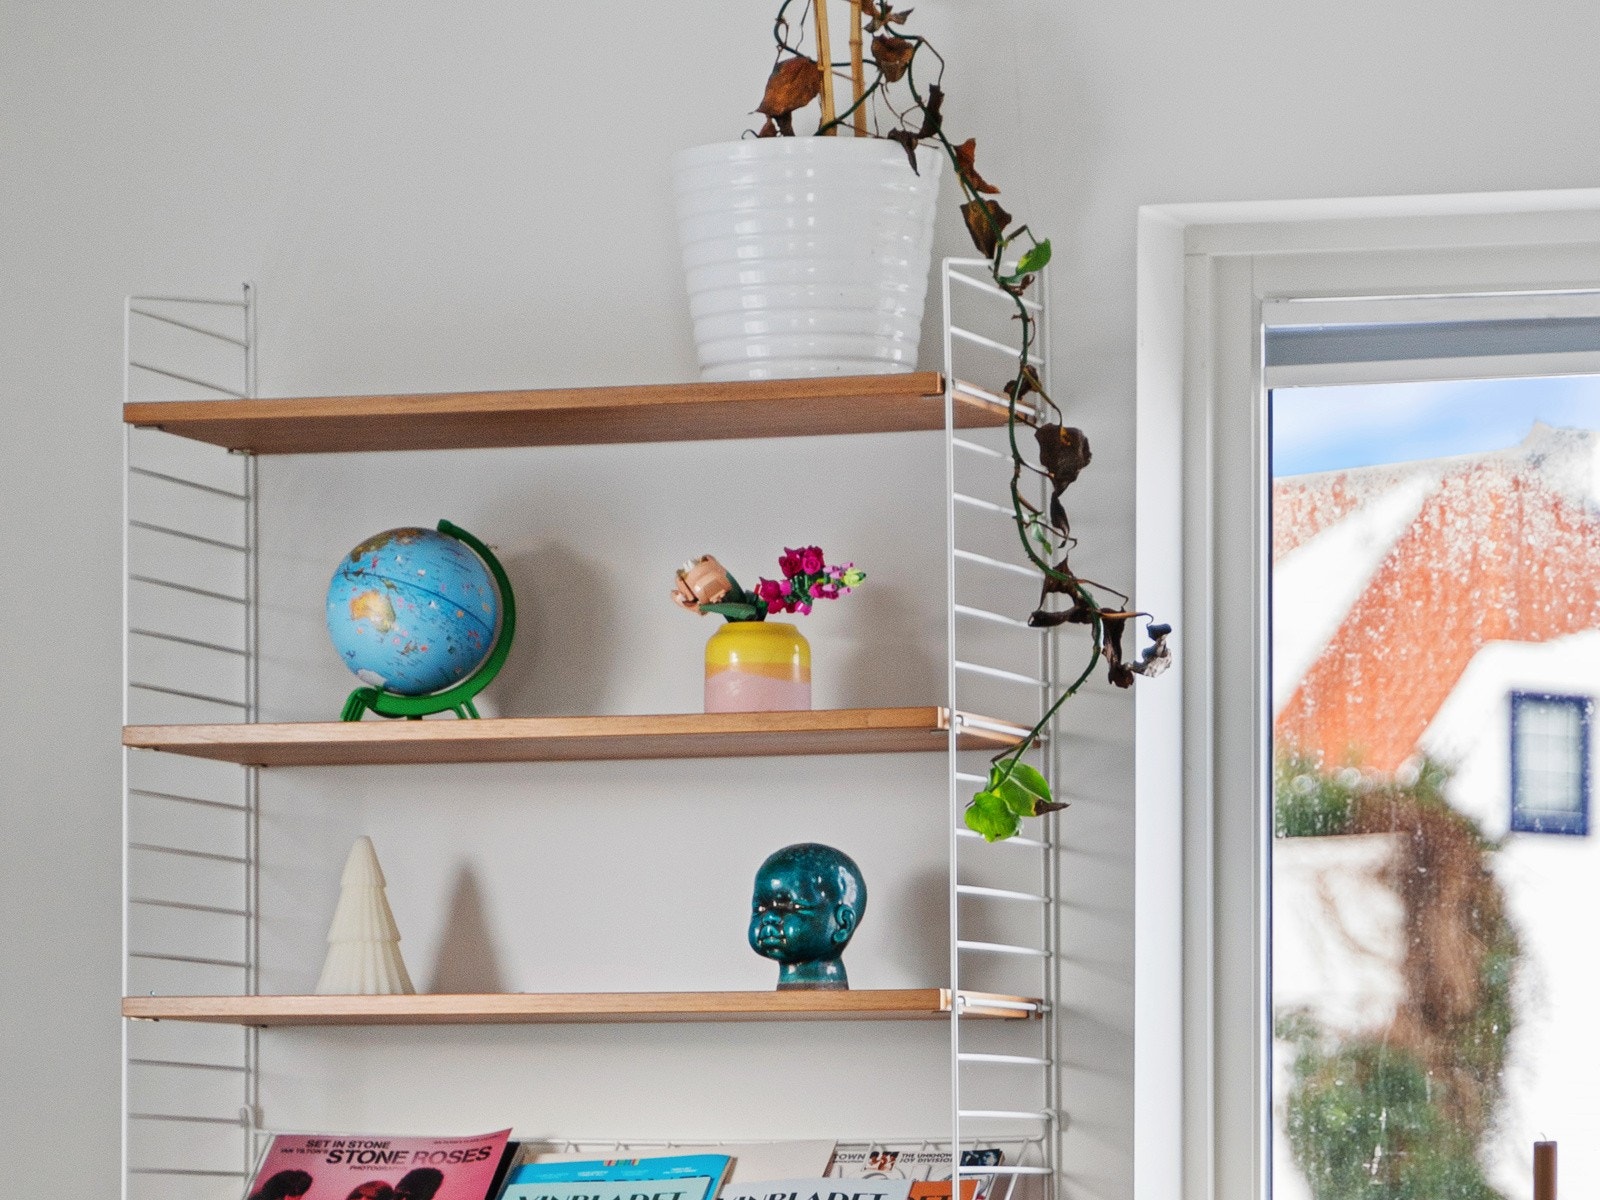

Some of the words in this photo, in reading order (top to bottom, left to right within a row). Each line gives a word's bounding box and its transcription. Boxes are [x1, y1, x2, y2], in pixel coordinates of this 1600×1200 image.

[306, 1140, 332, 1148] SET
[333, 1140, 346, 1149] IN
[347, 1140, 391, 1150] STONE
[325, 1149, 410, 1166] STONE
[411, 1145, 493, 1165] ROSES
